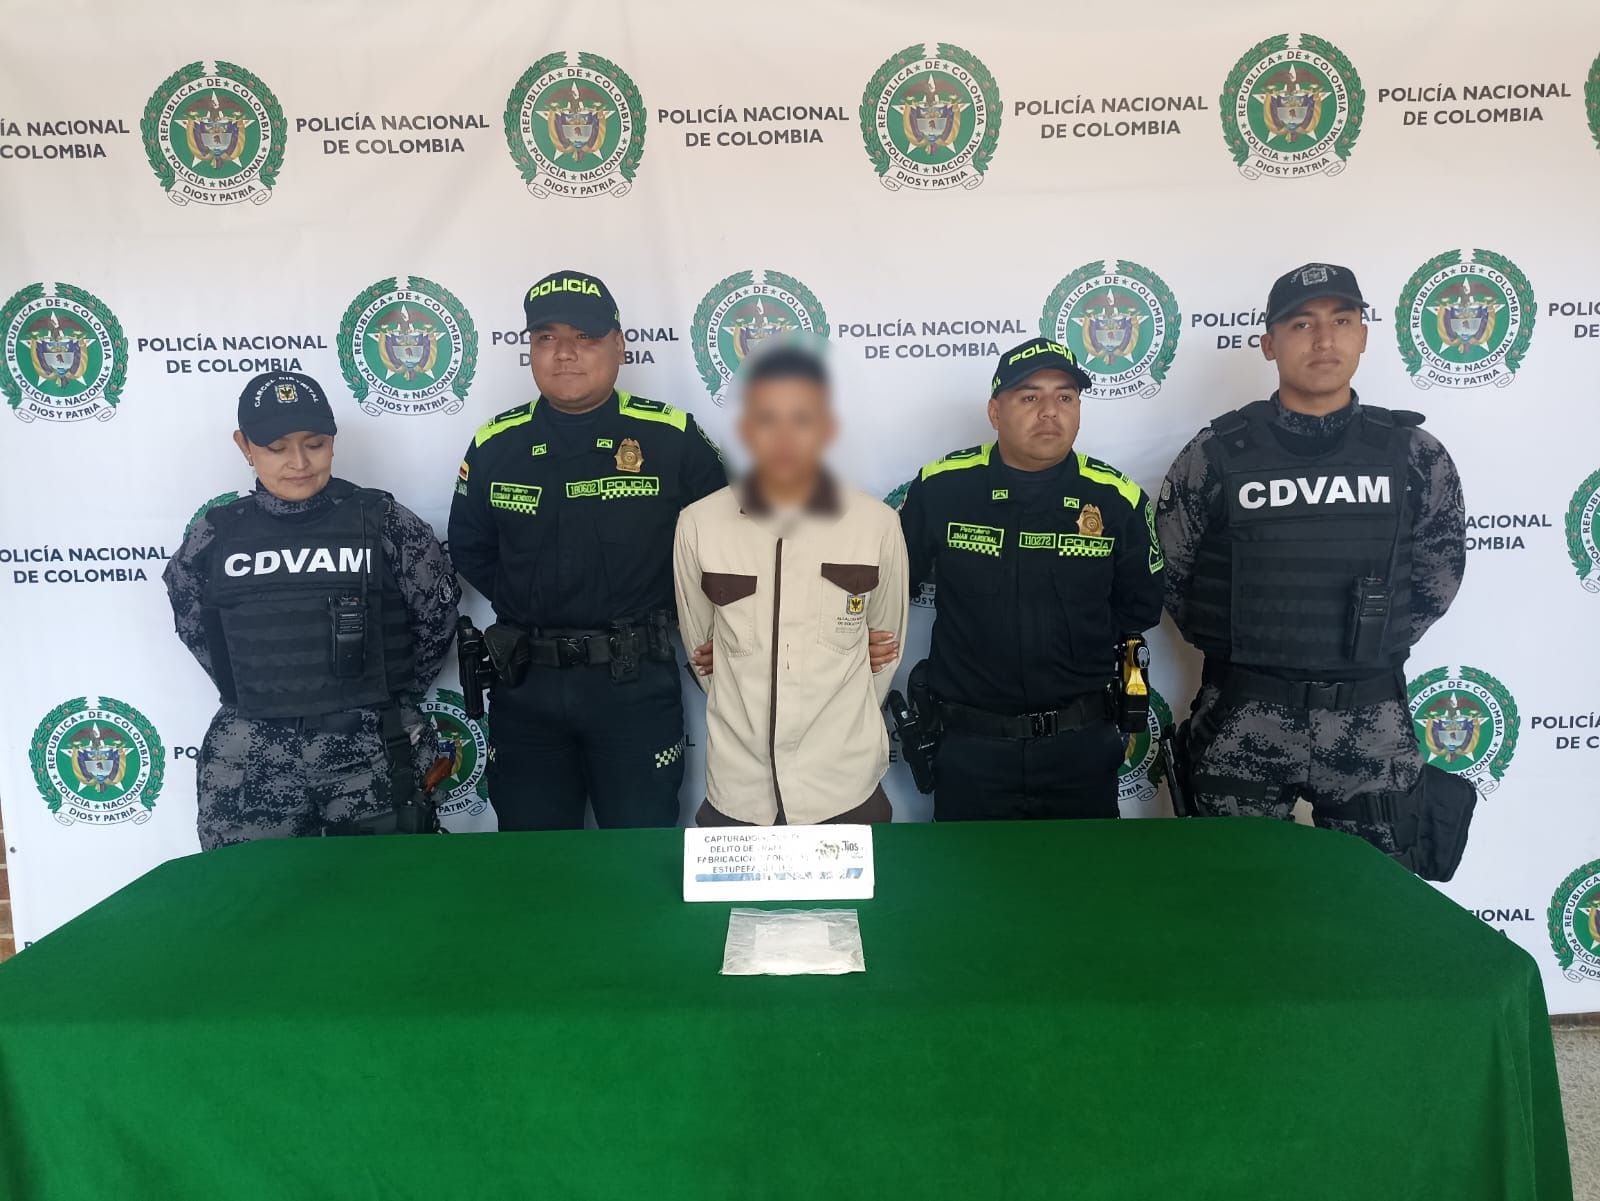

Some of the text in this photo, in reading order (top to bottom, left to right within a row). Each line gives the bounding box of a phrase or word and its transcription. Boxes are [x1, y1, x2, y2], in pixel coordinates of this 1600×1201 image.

[1287, 51, 1302, 60] DE
[1313, 57, 1346, 113] COLOMBIA
[567, 68, 581, 77] DE
[593, 74, 629, 133] COLOMBIA
[925, 62, 939, 70] DE
[950, 67, 984, 126] COLOMBIA
[1379, 82, 1572, 103] POLICÍA NACIONAL
[206, 79, 221, 87] DE
[233, 84, 269, 141] COLOMBIA
[658, 104, 850, 125] POLICÍA NACIONAL
[1015, 95, 1209, 117] POLICÍA NACIONAL
[296, 112, 490, 133] POLICÍA NACIONAL
[1404, 107, 1544, 126] DE COLOMBIA
[27, 119, 130, 136] NACIONAL
[1041, 120, 1181, 139] DE COLOMBIA
[323, 138, 465, 155] DE COLOMBIA
[686, 129, 824, 148] DE COLOMBIA
[1292, 126, 1343, 161] NACIONAL
[0, 143, 107, 159] COLOMBIA
[932, 138, 980, 174] NACIONAL
[219, 154, 266, 188] NACIONAL
[579, 146, 626, 181] NACIONAL
[1256, 158, 1329, 175] DIOS Y PATRIA
[544, 178, 616, 195] DIOS Y PATRIA
[897, 171, 968, 188] DIOS Y PATRIA
[183, 185, 255, 201] DIOS Y PATRIA
[529, 278, 602, 301] POLICÍA
[1461, 265, 1476, 273] DE
[1486, 270, 1519, 326] COLOMBIA
[753, 286, 767, 294] DE
[779, 291, 812, 332] COLOM
[1105, 276, 1119, 285] DE
[1130, 281, 1163, 337] COLOMBIA
[46, 299, 61, 307] DE
[73, 304, 111, 360] COLOMBIA
[397, 293, 412, 301] DE
[423, 298, 461, 354] COLOMBIA
[839, 318, 1027, 338] POLICÍA NACIONAL
[1574, 324, 1600, 339] DE
[137, 332, 328, 353] POLICÍA NACIONAL
[624, 328, 679, 342] ONAL
[1217, 335, 1242, 349] DE
[865, 342, 1000, 359] DE COLOMBIA
[1464, 338, 1513, 372] NACIONAL
[166, 357, 303, 374] DE COLOMBIA
[1110, 349, 1158, 383] NACIONAL
[412, 366, 458, 399] NACIONAL
[1428, 369, 1500, 385] DIOS Y PATRIA
[64, 373, 109, 406] NACIONAL
[1099, 388, 1106, 397] Y
[1109, 380, 1145, 396] PATRIA
[29, 403, 101, 419] DIOS Y PATRIA
[377, 396, 448, 412] DIOS Y PATRIA
[606, 480, 652, 489] POLICÍA
[1238, 476, 1390, 509] CDVAM
[1465, 514, 1552, 529] ACIONAL
[1465, 536, 1525, 550] OMBIA
[0, 545, 171, 562] OLICÍA NACIONAL
[224, 547, 371, 577] CDVAM
[14, 568, 147, 583] DE COLOMBIA
[1410, 681, 1503, 737] BLICA DE COLOMBIA
[427, 703, 485, 759] DE COLOMBIA
[1148, 710, 1160, 744] OMBIA
[88, 711, 102, 719] DE
[113, 716, 148, 767] COLOMBIA
[1556, 736, 1580, 750] DE
[1459, 748, 1497, 779] ACIONAL
[103, 779, 146, 810] NACIONAL
[1120, 784, 1143, 797] TRIA
[69, 807, 137, 822] DIOS Y PATRIA
[438, 798, 472, 814] PATRIA
[710, 845, 740, 853] DELITO
[1476, 909, 1535, 922] IONAL
